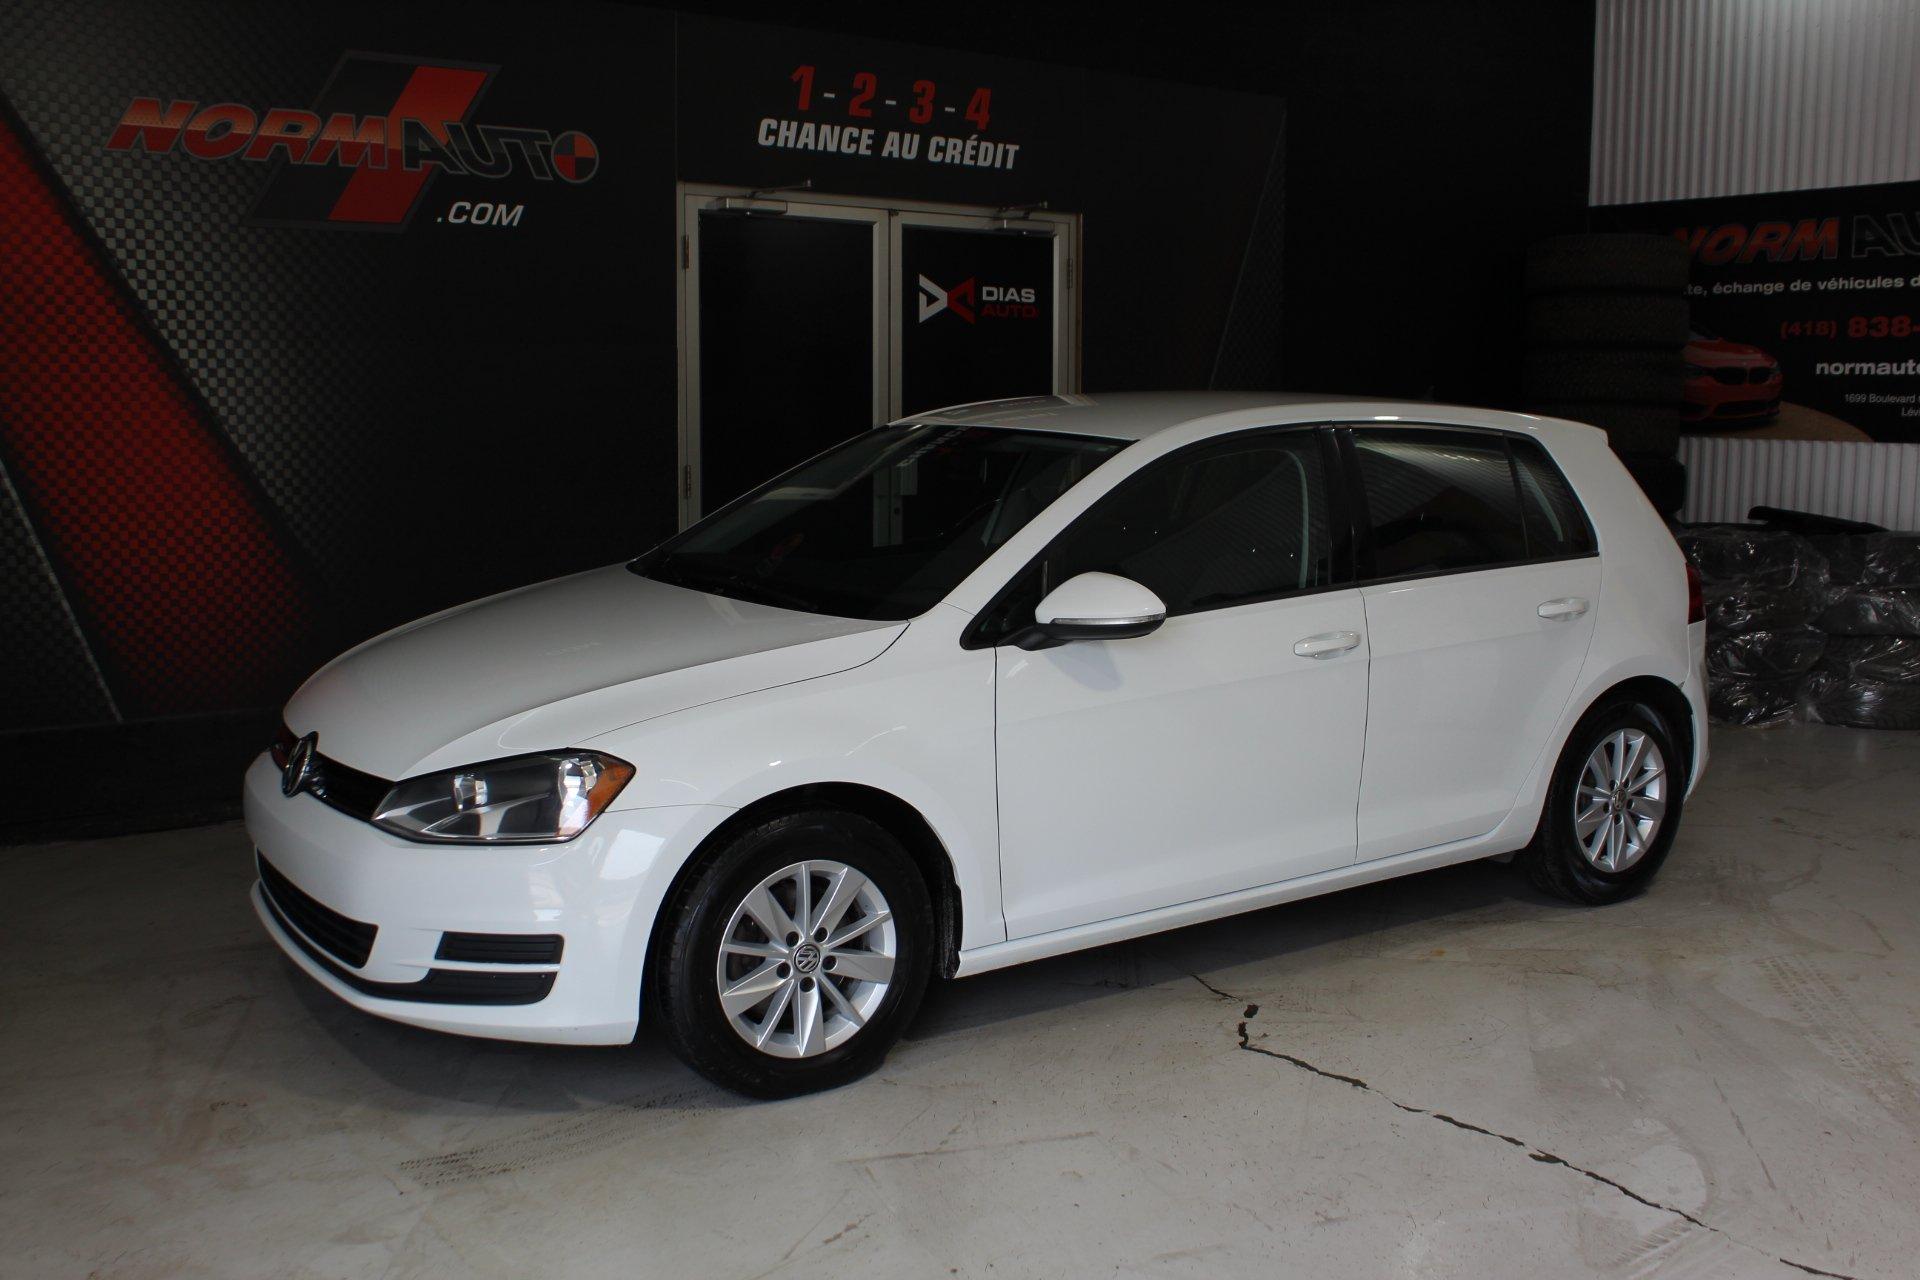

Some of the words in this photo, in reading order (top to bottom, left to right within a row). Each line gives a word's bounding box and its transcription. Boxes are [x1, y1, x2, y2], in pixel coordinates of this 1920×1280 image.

[757, 117, 876, 156] CHANCE
[881, 131, 921, 160] AU
[928, 133, 1020, 170] CRÉDIT
[436, 200, 525, 228] .COM
[982, 286, 1036, 303] DIAS
[1712, 279, 1785, 296] échange
[1790, 279, 1812, 291] de
[1817, 275, 1905, 290] véhicules
[980, 304, 1040, 320] AUTO
[1780, 320, 1838, 341] (418)
[1815, 358, 1920, 376] normaut
[1844, 393, 1867, 403] 1699
[1868, 393, 1916, 404] Boulevard
[1901, 406, 1920, 417] Lév
